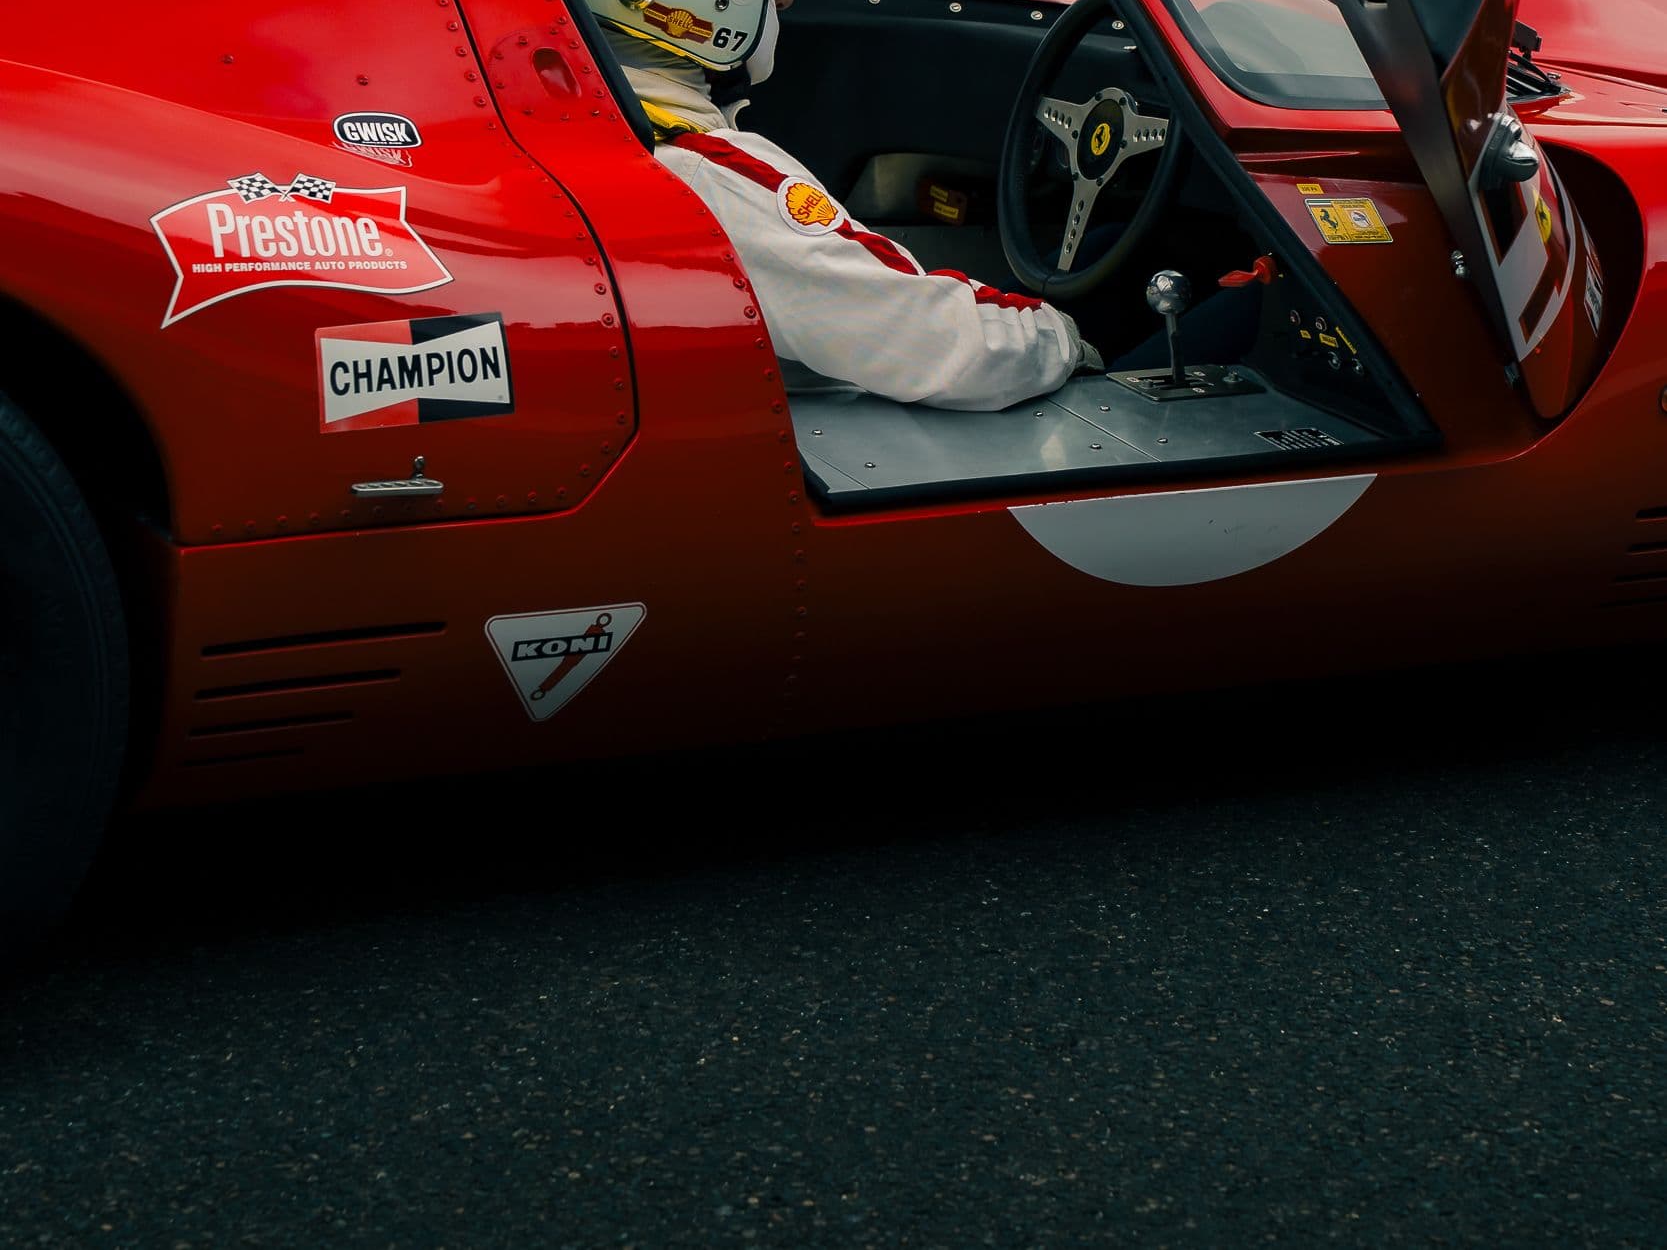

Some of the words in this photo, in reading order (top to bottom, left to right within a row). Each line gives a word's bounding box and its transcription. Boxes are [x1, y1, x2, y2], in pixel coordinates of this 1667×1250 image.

[712, 27, 748, 52] 67
[343, 122, 412, 142] GWISK
[797, 190, 824, 219] SHELL
[206, 203, 386, 258] Prestone
[192, 262, 222, 273] HIGH
[225, 261, 311, 273] PERFORMANCE
[315, 261, 346, 271] AUTO
[349, 260, 408, 271] PRODUCTS
[330, 346, 501, 396] CHAMPION
[516, 635, 609, 658] KONI
